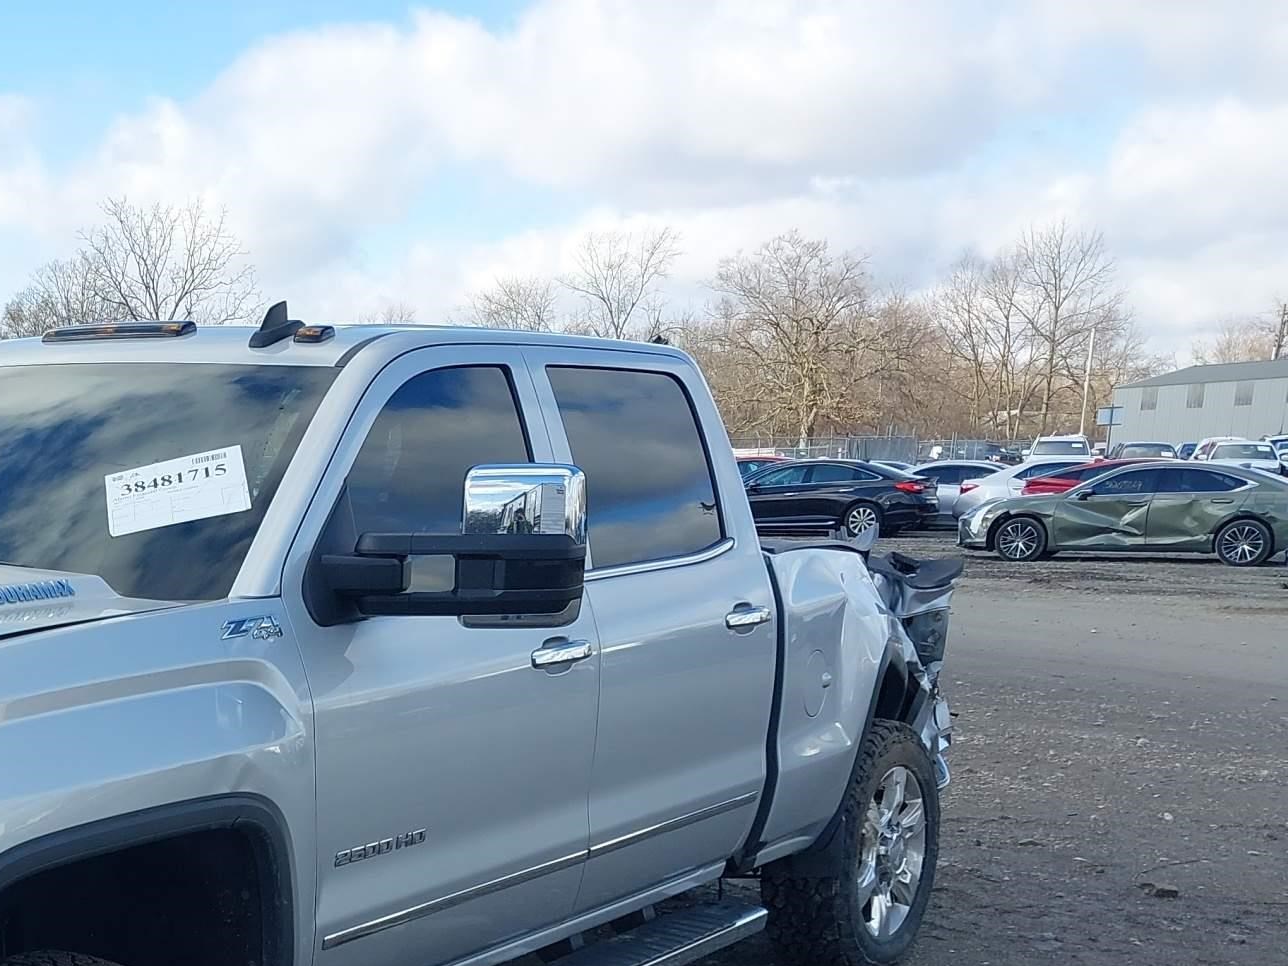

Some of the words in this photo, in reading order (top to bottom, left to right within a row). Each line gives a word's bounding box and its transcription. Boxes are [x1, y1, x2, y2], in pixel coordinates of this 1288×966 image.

[120, 463, 228, 497] 38481715
[334, 838, 393, 868] 2500
[395, 828, 426, 850] HD
